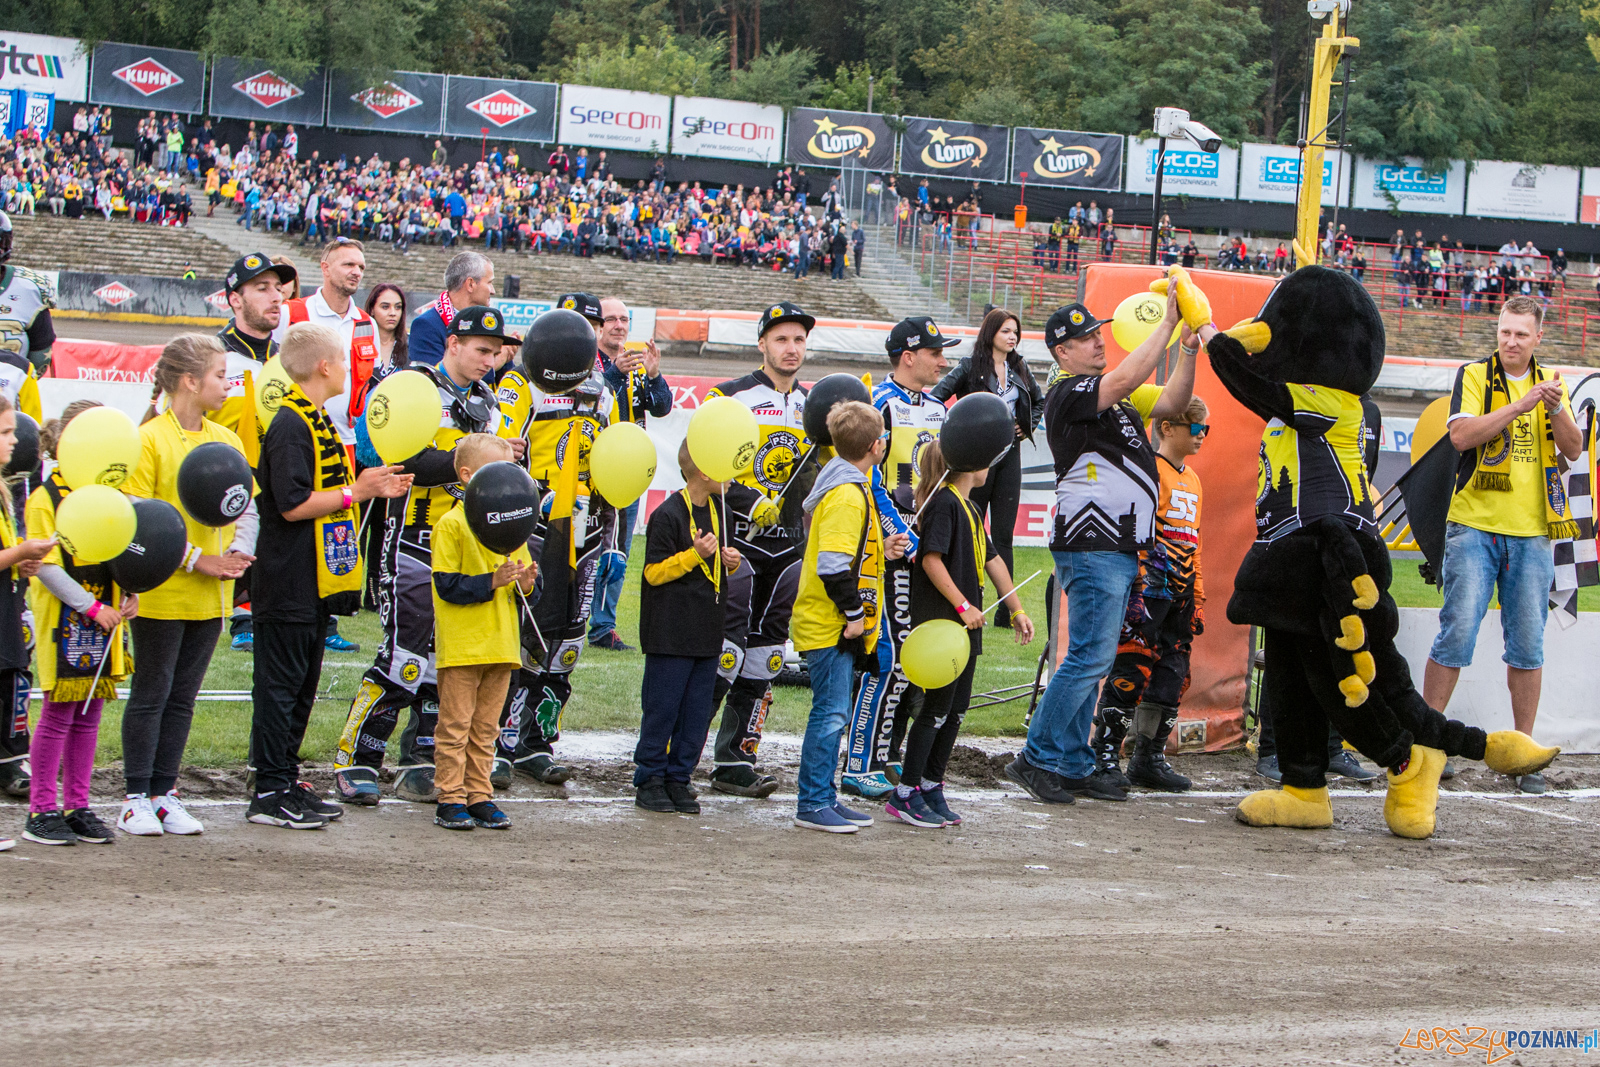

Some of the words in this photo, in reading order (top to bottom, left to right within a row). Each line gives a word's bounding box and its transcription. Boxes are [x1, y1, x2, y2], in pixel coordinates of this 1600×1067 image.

[125, 68, 172, 86] KUHN
[245, 81, 292, 98] KUHN
[478, 100, 525, 116] KUHN
[588, 132, 641, 143] www.seecom.pl
[821, 132, 862, 153] LOTTO
[700, 142, 754, 154] www.seecom.pl
[934, 142, 975, 163] LOTTO
[1047, 152, 1088, 173] LOTTO
[100, 287, 130, 299] KUHN
[851, 675, 880, 755] aromatino.com
